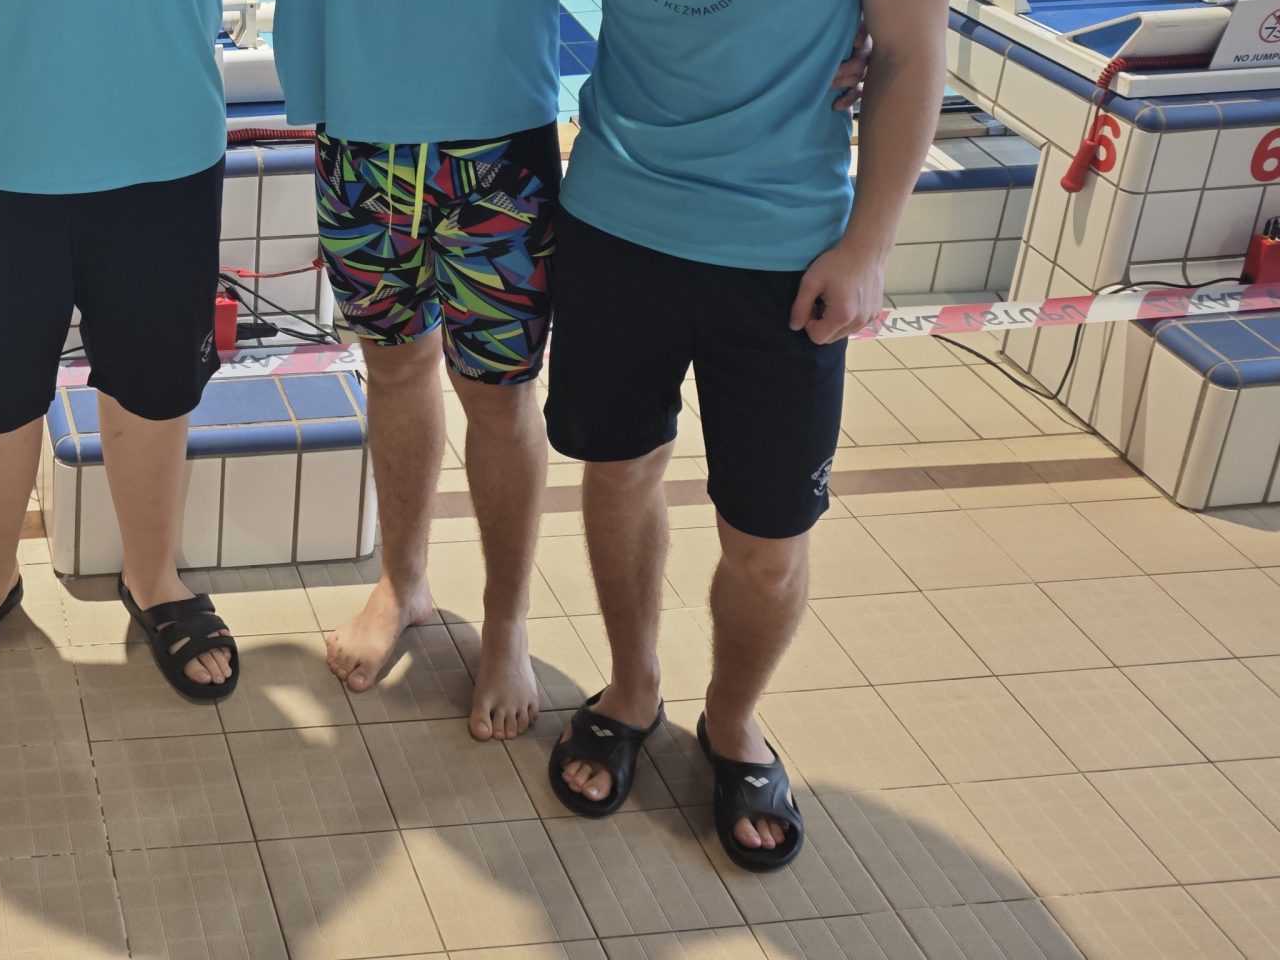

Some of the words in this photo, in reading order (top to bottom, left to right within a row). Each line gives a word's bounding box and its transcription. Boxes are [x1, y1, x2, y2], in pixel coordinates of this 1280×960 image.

[1233, 54, 1250, 63] NO
[1089, 113, 1122, 173] 6
[1250, 128, 1280, 182] 6
